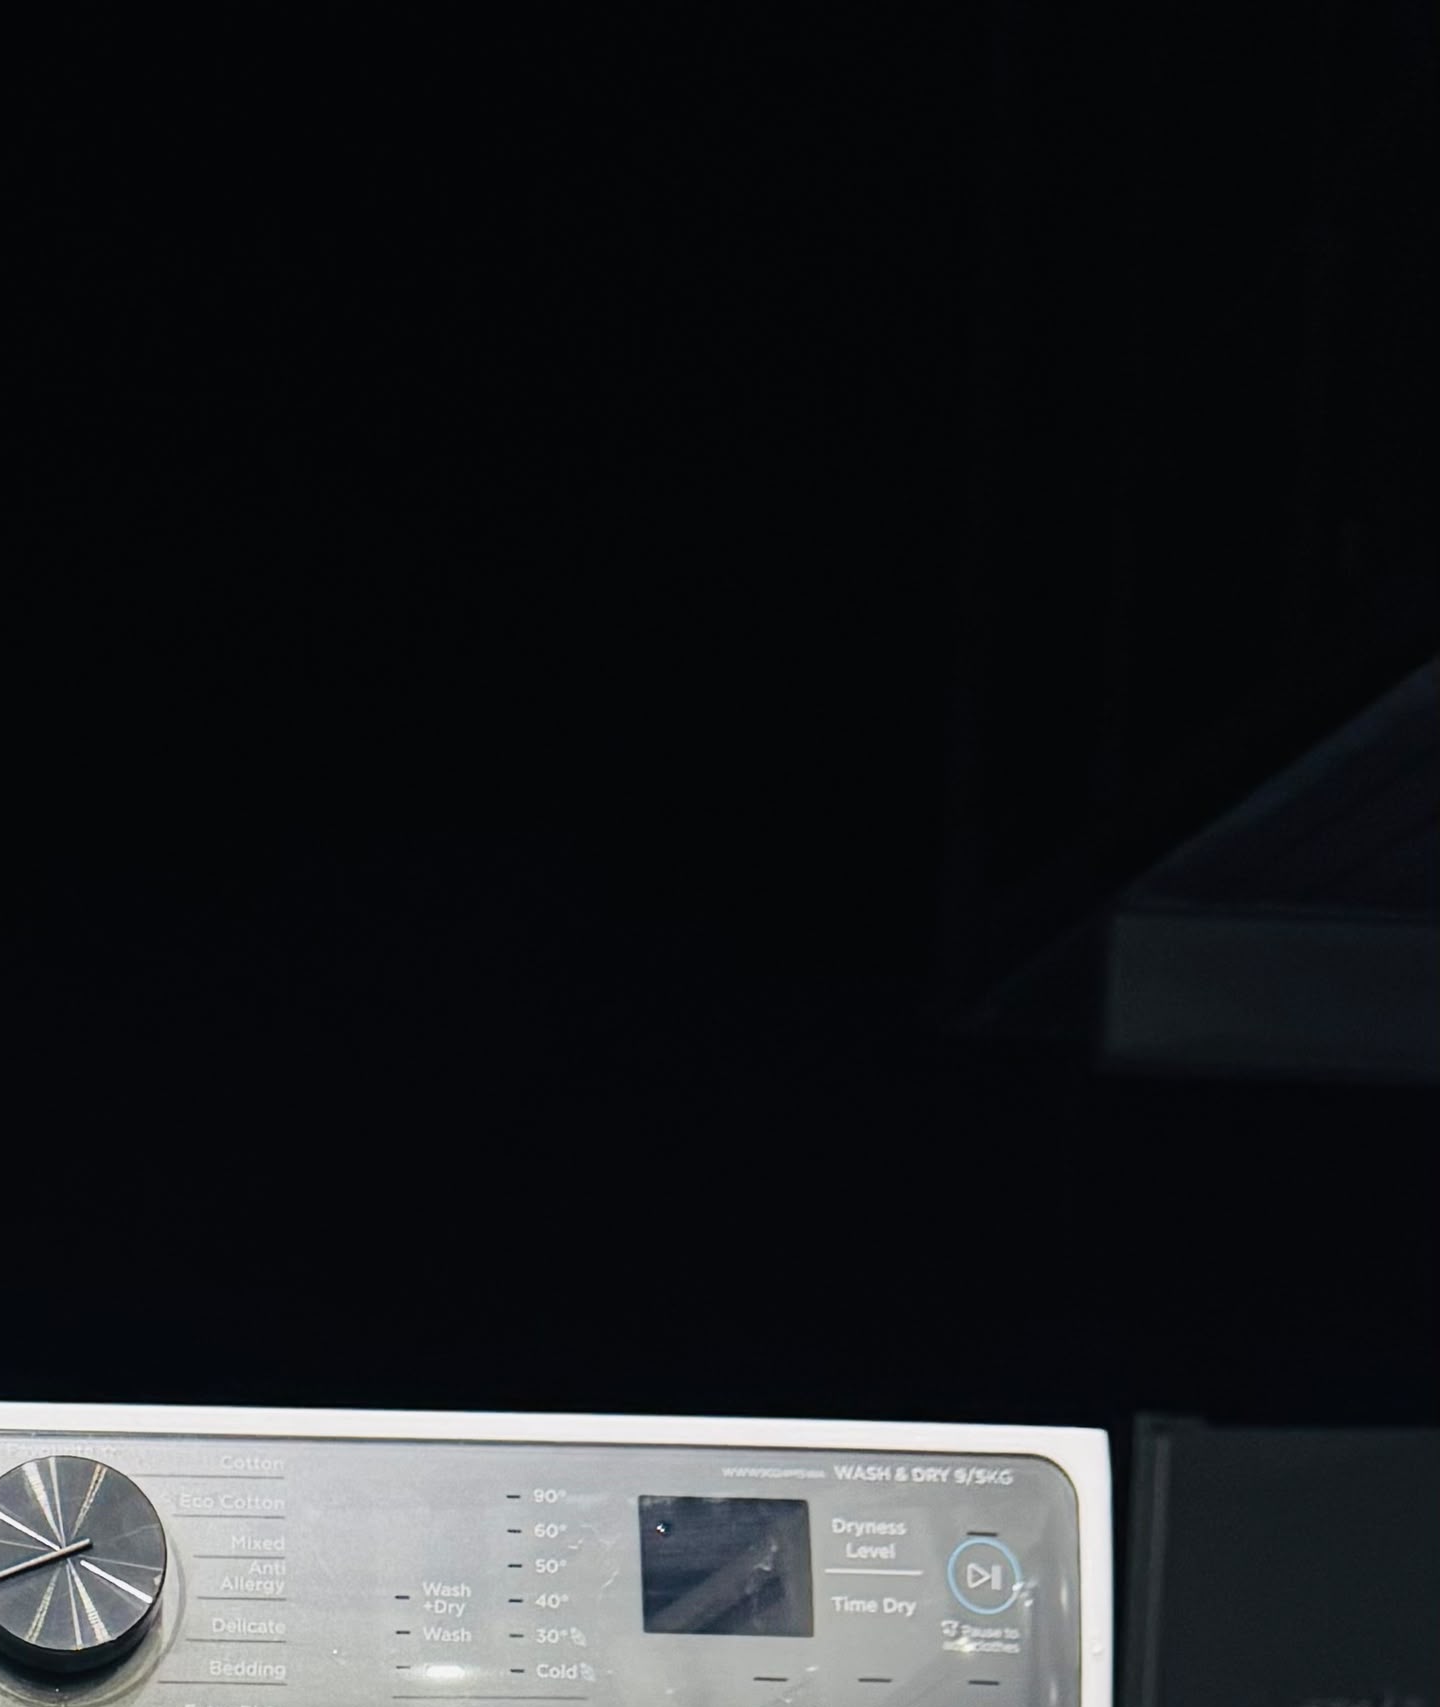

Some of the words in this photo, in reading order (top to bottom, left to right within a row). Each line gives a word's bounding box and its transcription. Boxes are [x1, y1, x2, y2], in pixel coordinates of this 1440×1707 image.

[221, 1456, 285, 1472] Cotton
[834, 1466, 891, 1482] WASH
[894, 1467, 910, 1482] &
[912, 1468, 949, 1483] DRY
[180, 1494, 214, 1510] Eco
[220, 1495, 285, 1511] Cotton
[534, 1523, 567, 1538] 60°
[832, 1518, 908, 1537] Dryness
[231, 1536, 286, 1552] Mixed
[846, 1543, 896, 1560] Level
[250, 1560, 286, 1576] Anti
[535, 1558, 568, 1574] 50°
[220, 1576, 286, 1595] Allergy
[422, 1582, 472, 1598] Wash
[424, 1600, 466, 1618] +Dry
[535, 1593, 569, 1609] 40°
[830, 1597, 877, 1613] Time
[883, 1598, 917, 1617] Dry
[212, 1618, 287, 1635] Delicate
[422, 1627, 472, 1642] Wash
[536, 1629, 569, 1644] 30°
[210, 1661, 287, 1680] Bedding
[536, 1663, 578, 1679] Cold
